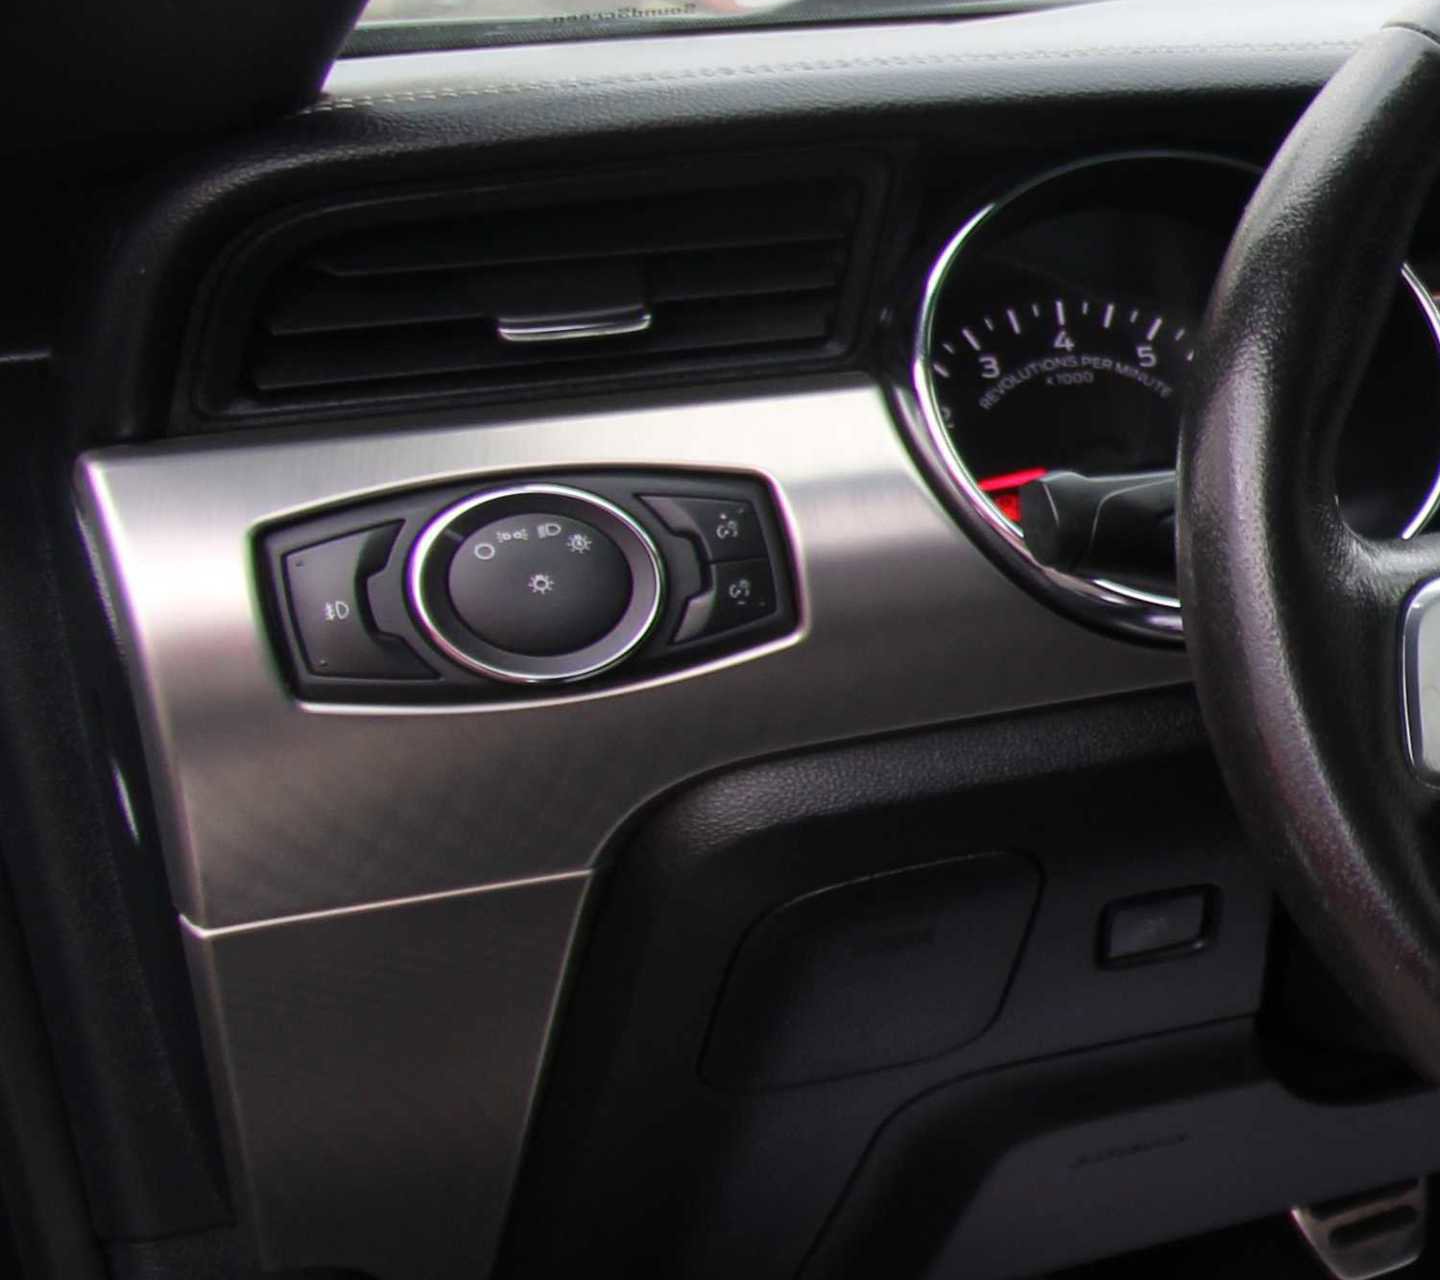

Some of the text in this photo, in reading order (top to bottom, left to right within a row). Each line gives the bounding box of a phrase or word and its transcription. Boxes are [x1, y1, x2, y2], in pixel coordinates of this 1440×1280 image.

[1053, 330, 1076, 352] 4
[979, 356, 1001, 380] 3
[1136, 346, 1158, 368] 5
[978, 354, 1174, 411] REVOLUTIONS PER MINUTE
[1054, 371, 1095, 385] 1000
